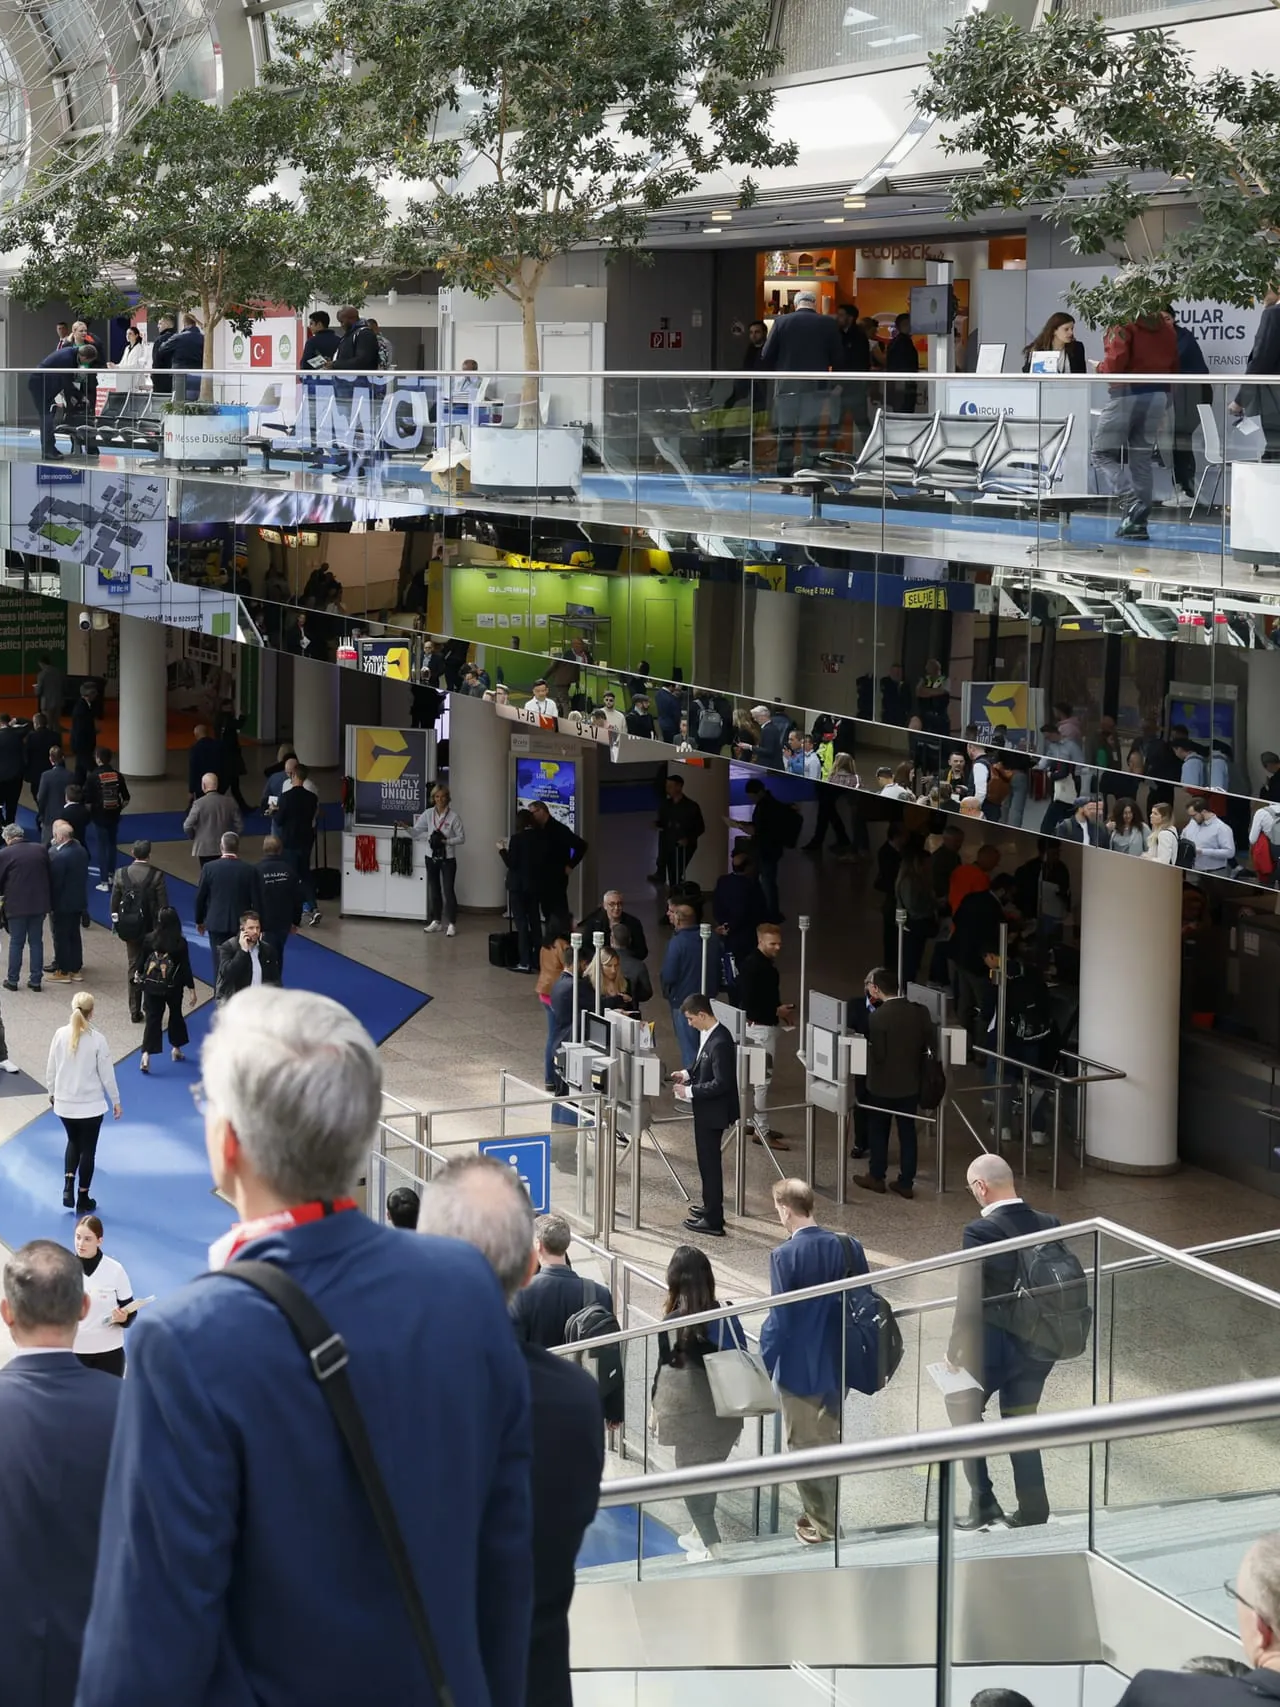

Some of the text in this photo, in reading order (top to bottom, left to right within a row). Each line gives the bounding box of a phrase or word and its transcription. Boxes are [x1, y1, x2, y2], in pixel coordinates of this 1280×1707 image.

[861, 243, 930, 264] ecopack
[175, 434, 200, 443] Messe
[381, 779, 420, 789] SIMPLY
[381, 788, 420, 801] UNIQUE
